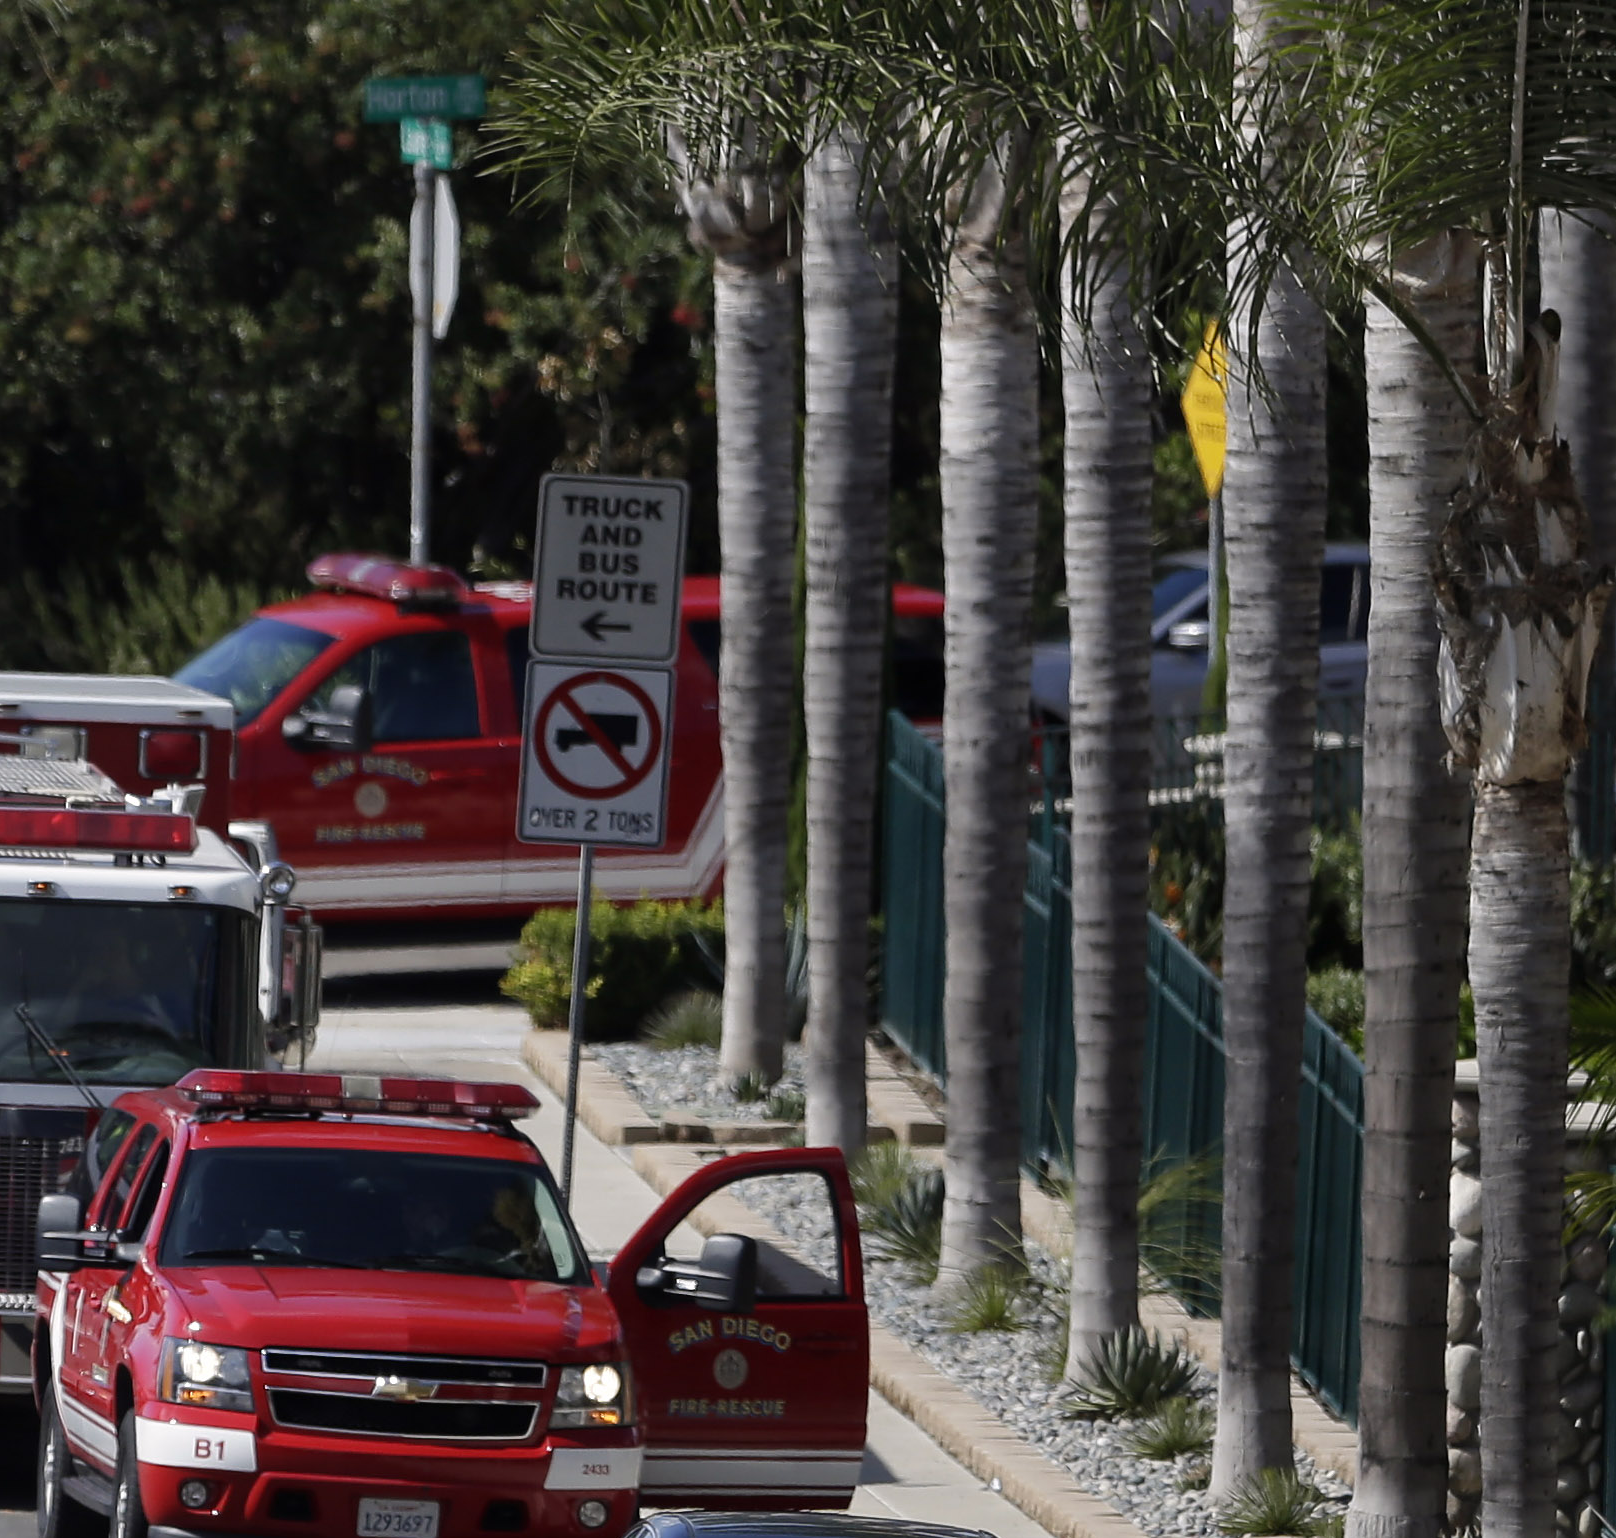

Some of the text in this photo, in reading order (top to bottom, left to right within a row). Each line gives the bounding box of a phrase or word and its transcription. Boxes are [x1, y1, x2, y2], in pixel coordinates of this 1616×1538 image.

[367, 84, 447, 111] Horton
[562, 495, 663, 521] TRUCK
[581, 525, 642, 548] AND
[578, 553, 639, 575] BUS
[557, 578, 658, 605] ROUTE
[312, 755, 427, 787] SAN DIEGO
[530, 808, 653, 834] OVER 2 TONS
[668, 1317, 792, 1353] SAN DIEGO
[669, 1399, 785, 1416] FIRE-RESCUE
[195, 1438, 225, 1461] B1
[364, 1511, 433, 1533] 1293697
